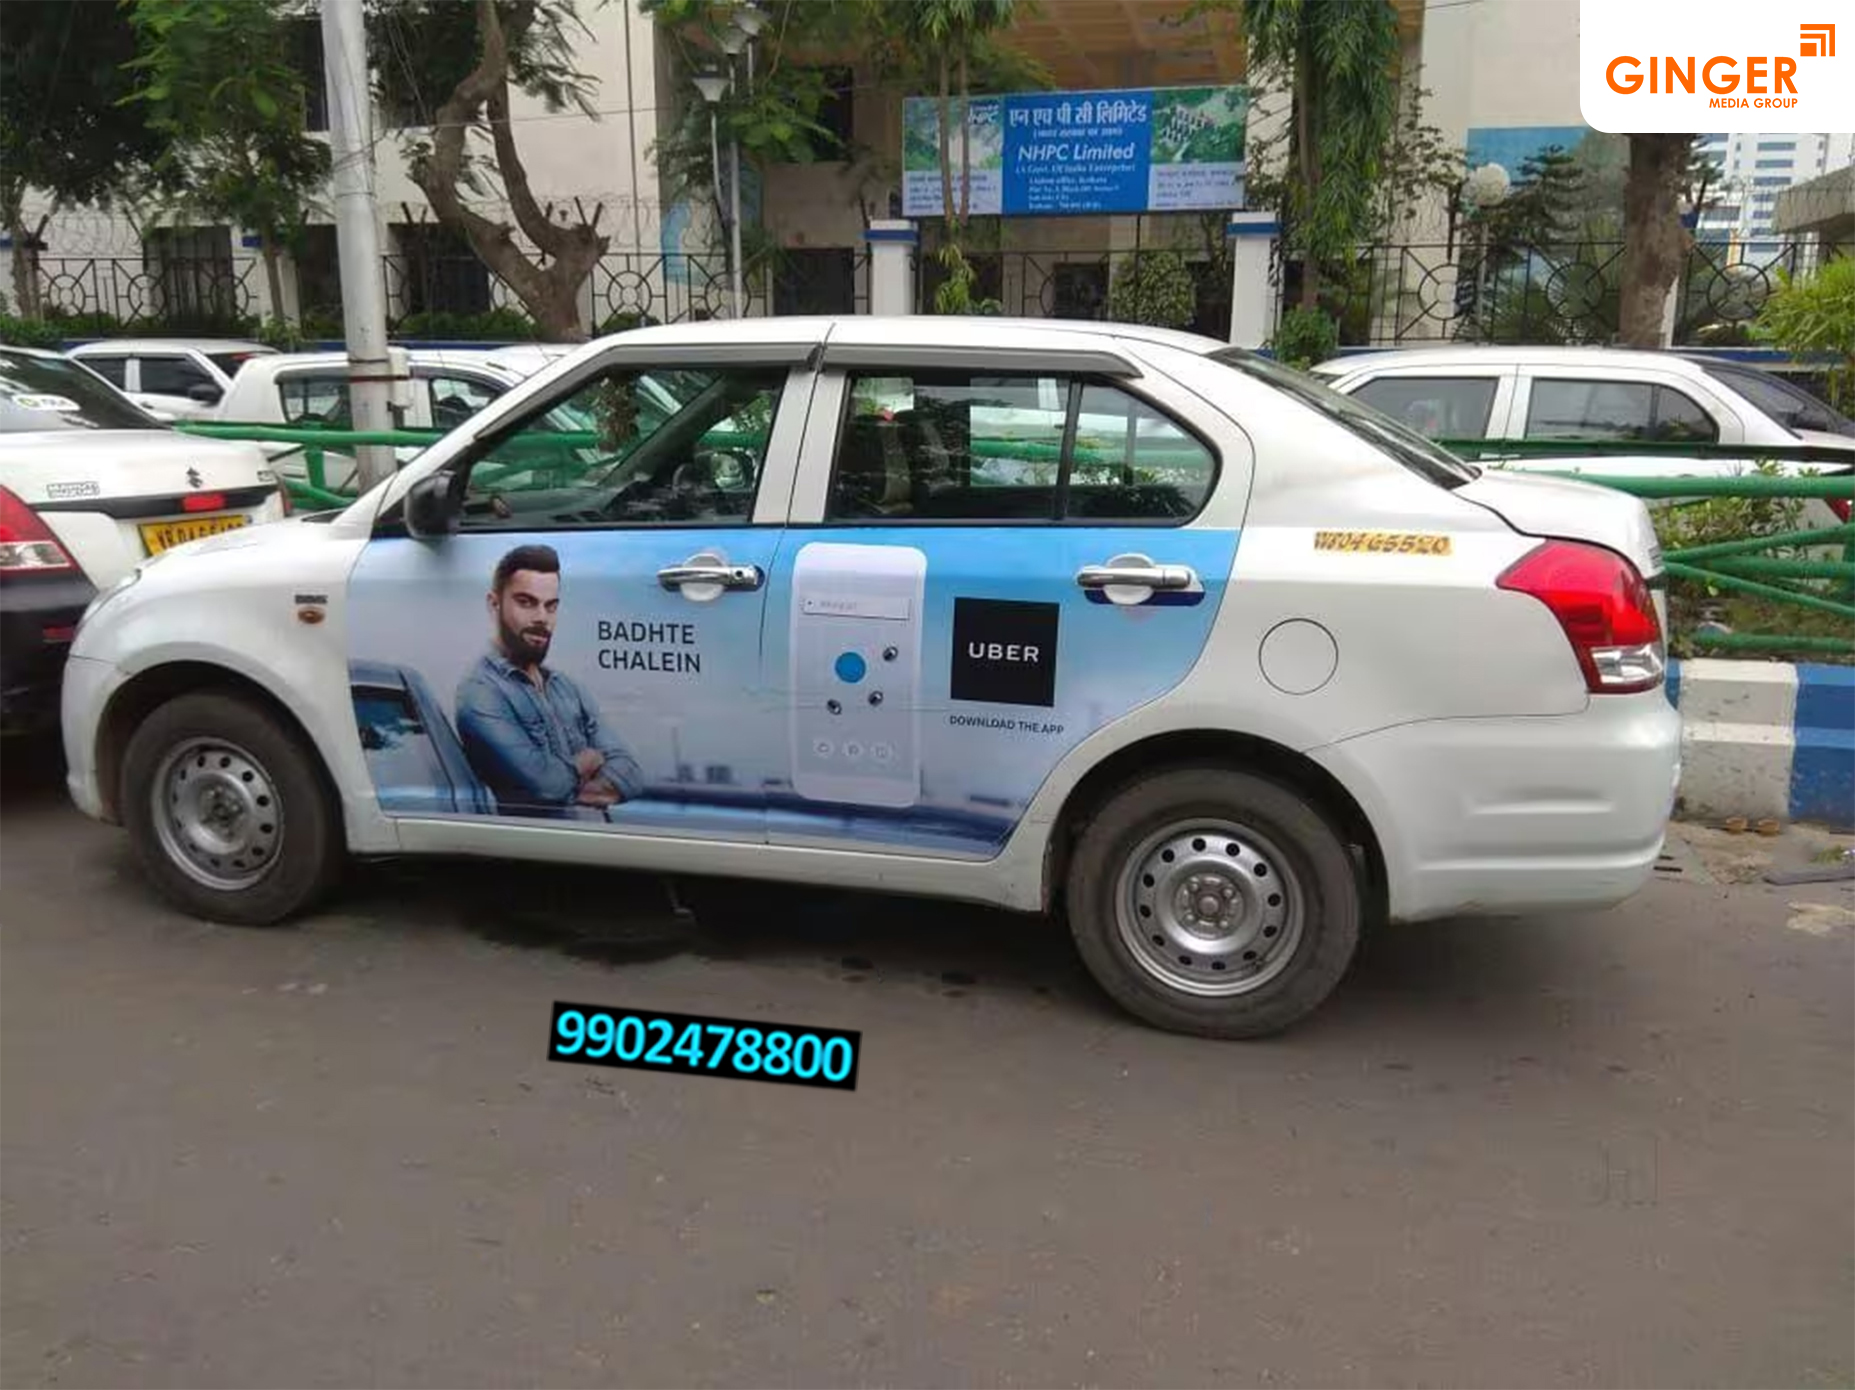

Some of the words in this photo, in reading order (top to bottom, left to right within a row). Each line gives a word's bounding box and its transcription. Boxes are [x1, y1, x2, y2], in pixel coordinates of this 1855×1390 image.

[1018, 144, 1069, 160] NHPC
[1073, 142, 1135, 160] Limited
[598, 620, 695, 644] BADHTE
[598, 649, 700, 673] CHALEIN
[968, 641, 1039, 662] UBER
[950, 715, 1015, 730] DOWNLOAD
[1018, 721, 1039, 733] THE
[1041, 724, 1064, 734] APP
